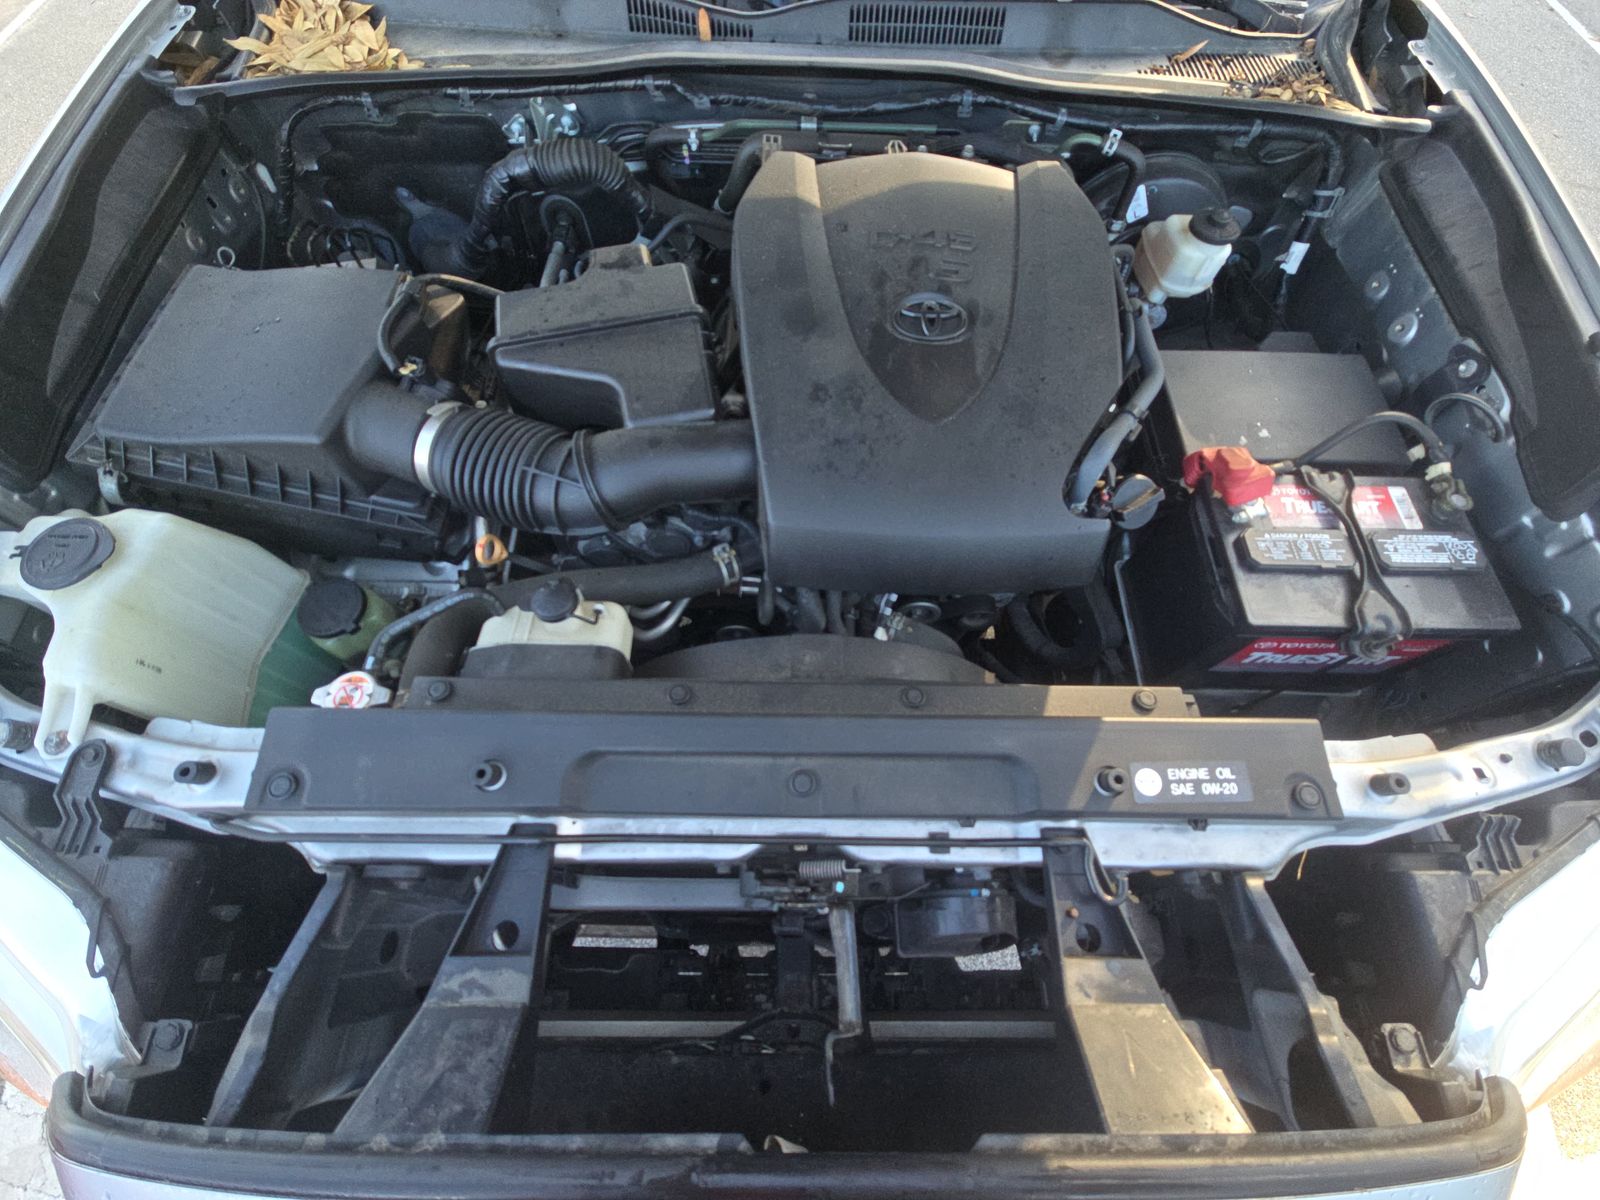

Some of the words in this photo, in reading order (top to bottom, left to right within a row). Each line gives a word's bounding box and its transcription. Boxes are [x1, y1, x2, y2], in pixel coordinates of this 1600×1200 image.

[1281, 487, 1314, 496] TOYOT
[1167, 767, 1210, 780] ENGINE
[1215, 767, 1237, 779] OIL
[1170, 783, 1195, 795] SAE
[1201, 782, 1239, 795] 0W-20
